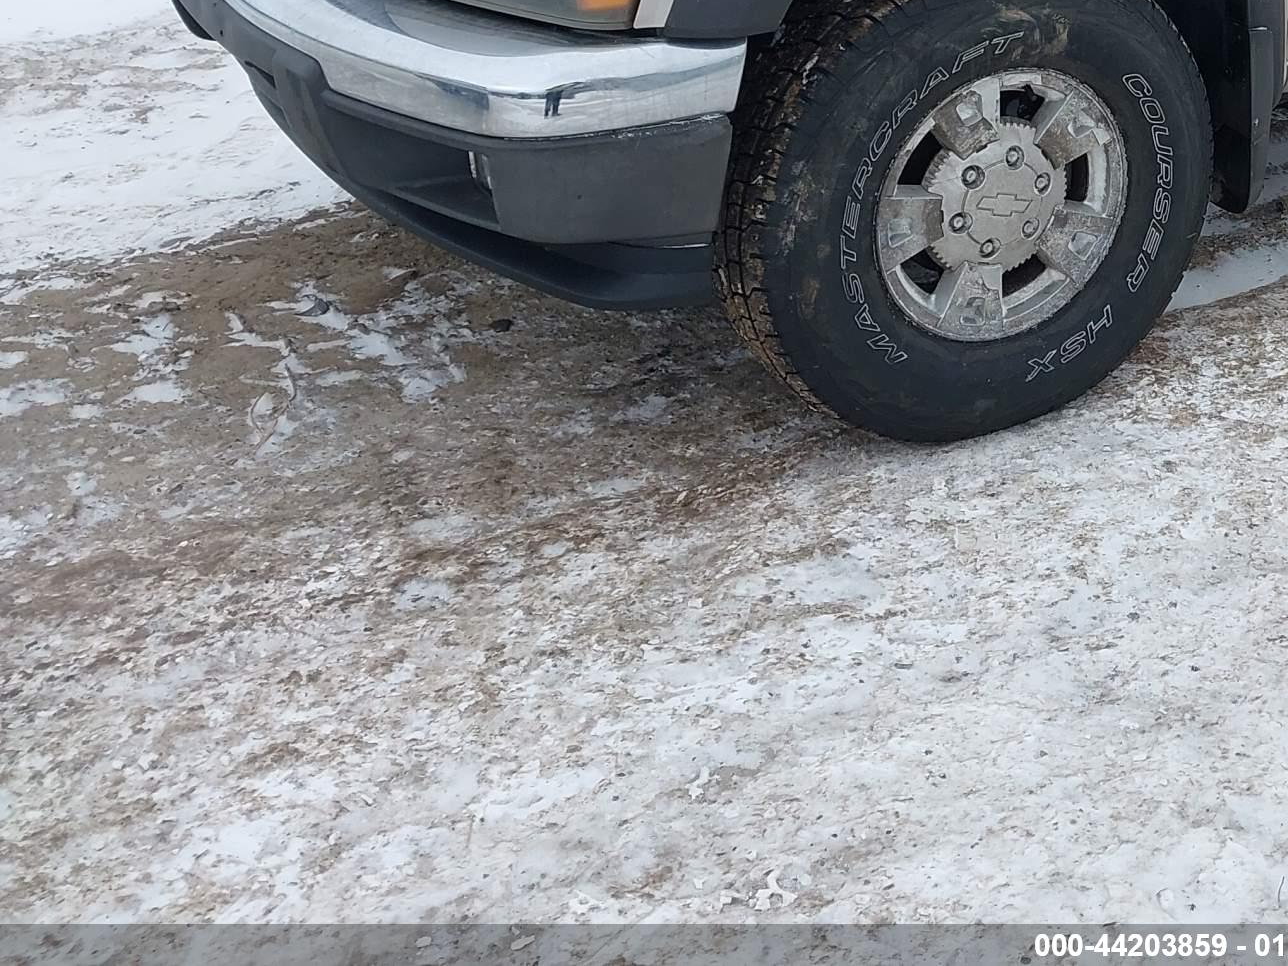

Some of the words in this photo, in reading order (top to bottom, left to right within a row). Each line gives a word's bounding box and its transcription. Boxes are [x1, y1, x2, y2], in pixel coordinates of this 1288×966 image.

[839, 31, 1024, 366] MASTERCRAFT
[1121, 72, 1176, 294] COURSER
[1024, 305, 1113, 383] HSX
